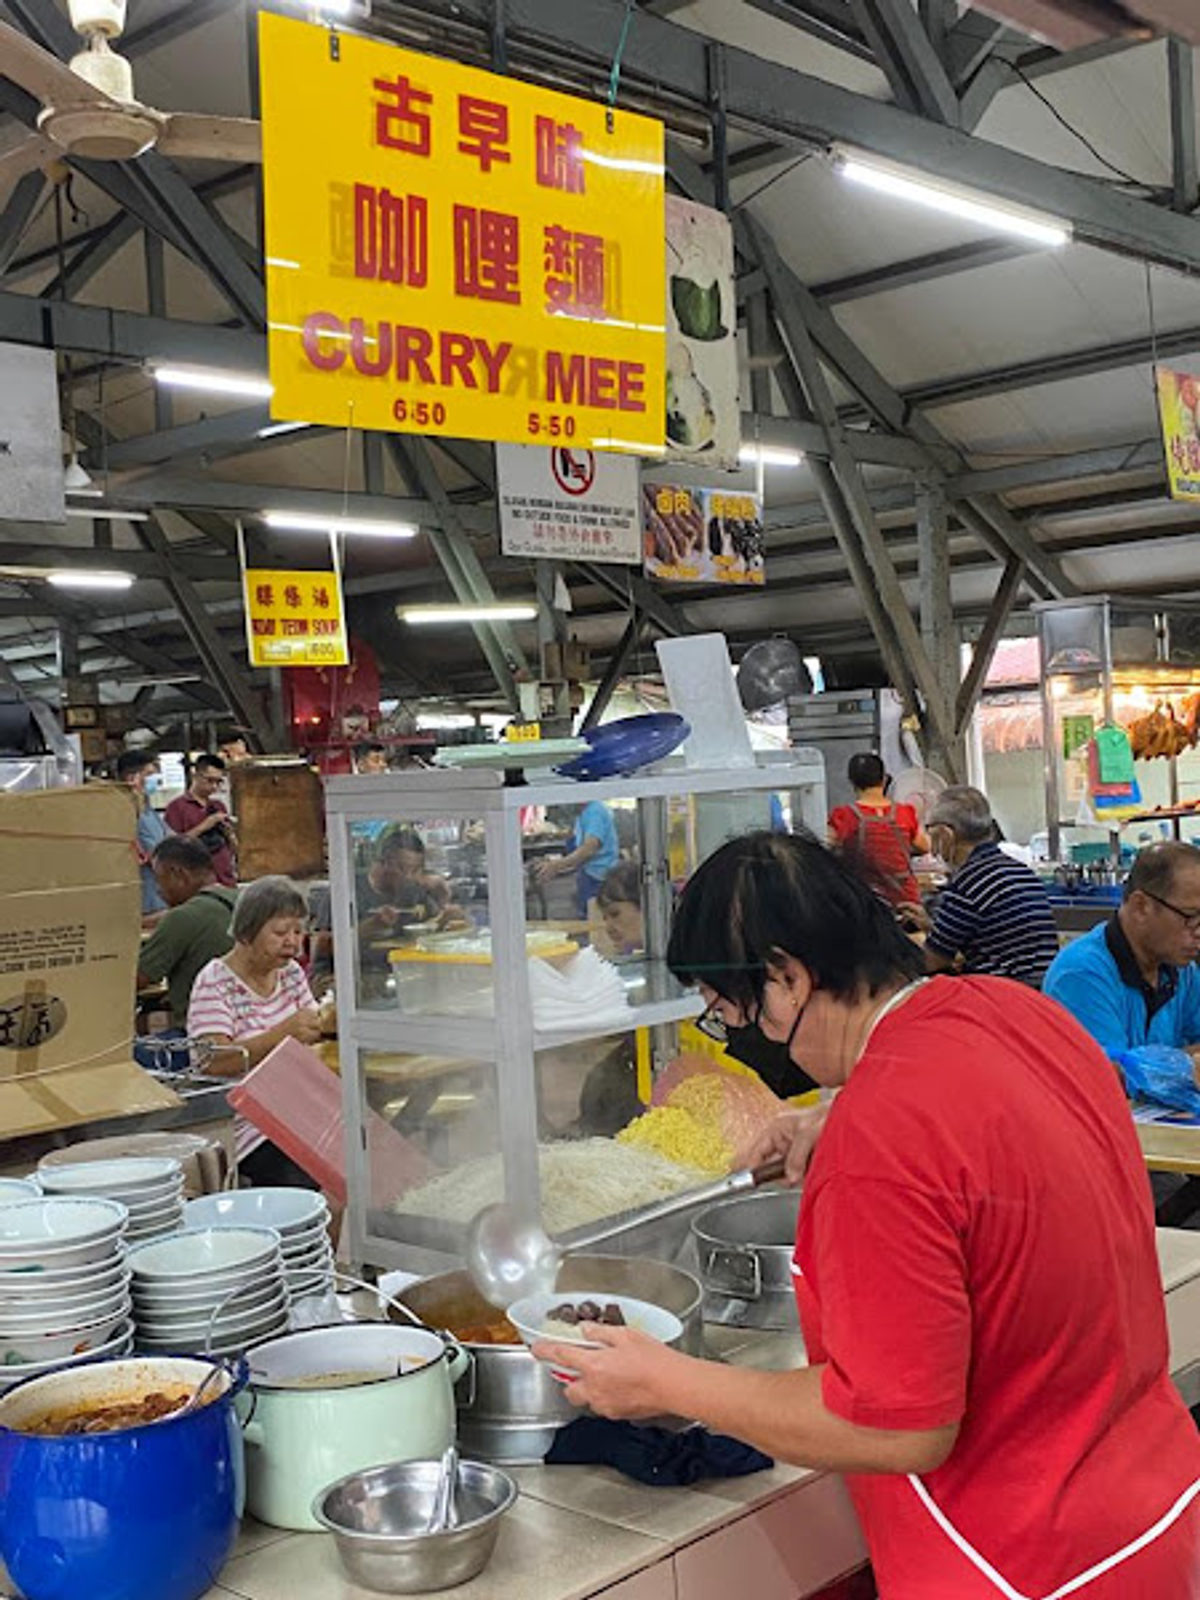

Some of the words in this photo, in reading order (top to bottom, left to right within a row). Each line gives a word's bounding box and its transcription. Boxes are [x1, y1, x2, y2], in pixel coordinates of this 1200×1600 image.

[373, 75, 586, 194] 古早味
[302, 311, 513, 394] CURRY
[546, 351, 646, 412] MEE
